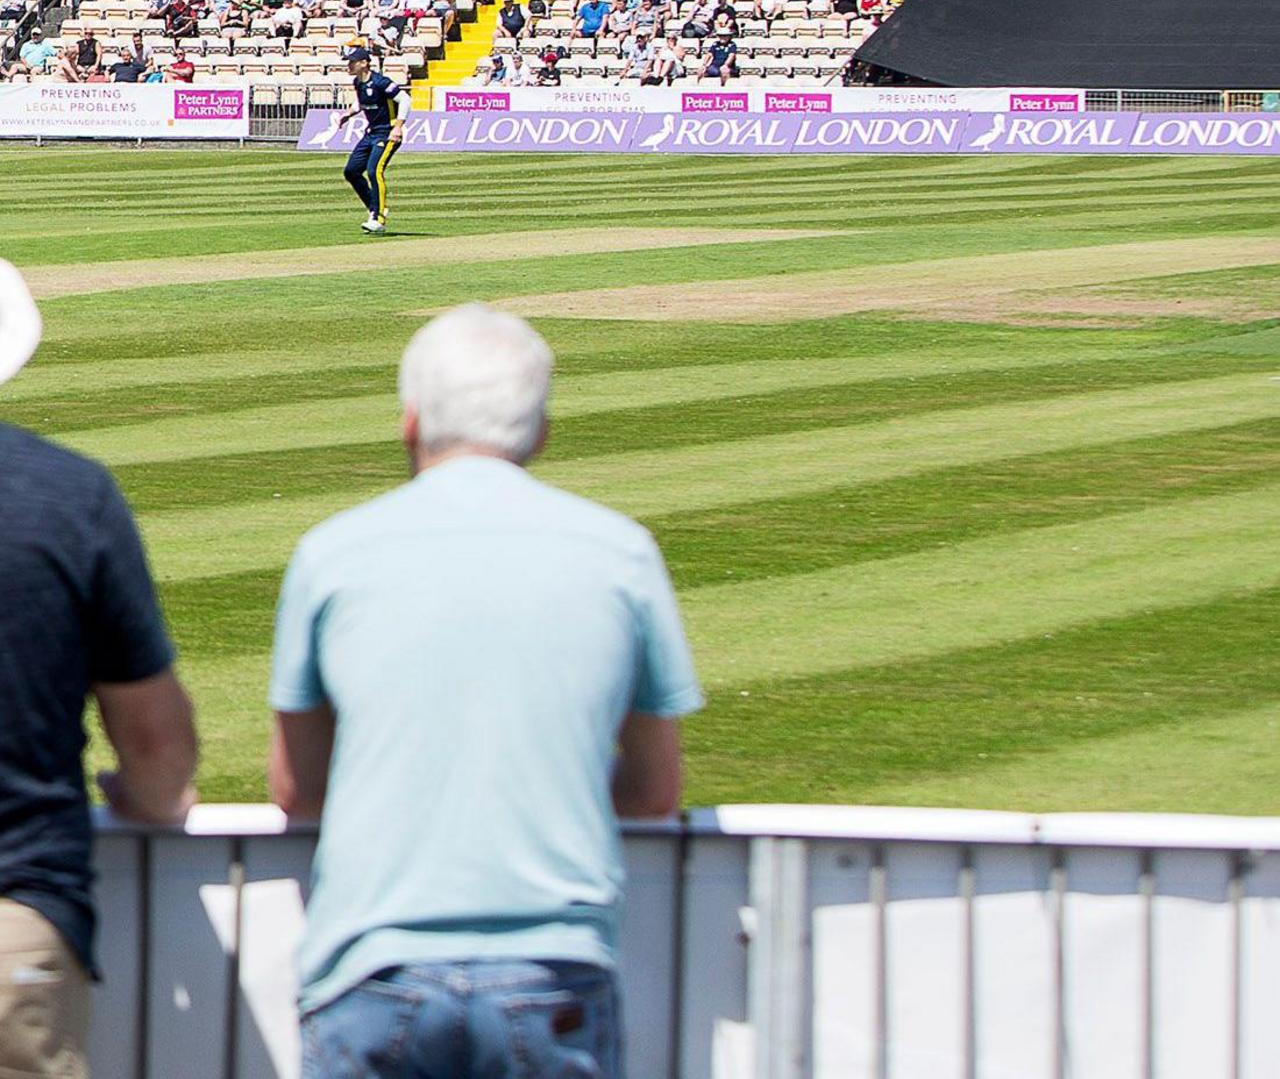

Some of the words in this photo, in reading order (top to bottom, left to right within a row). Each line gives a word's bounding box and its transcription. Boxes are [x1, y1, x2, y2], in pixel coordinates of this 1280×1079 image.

[41, 89, 122, 99] PREVENTING
[178, 93, 208, 105] Peter
[210, 94, 238, 107] Lynn
[555, 92, 630, 103] PREVENTING
[878, 93, 957, 104] PREVENTING
[26, 103, 64, 112] LEGAL
[70, 102, 137, 113] PROBLEMS
[448, 96, 476, 109] Peter
[478, 96, 507, 111] Lynn
[684, 97, 712, 109] Peter
[715, 97, 744, 111] Lynn
[768, 97, 796, 110] Peter
[799, 97, 828, 111] Lynn
[1011, 98, 1042, 110] Peter
[1044, 98, 1075, 112] Lynn
[188, 106, 238, 116] PARTNERS
[342, 117, 458, 145] RYAL
[472, 117, 629, 145] LONDON
[674, 118, 788, 146] ROYAL
[794, 118, 960, 146] LONDON
[1005, 118, 1123, 146] ROYAL
